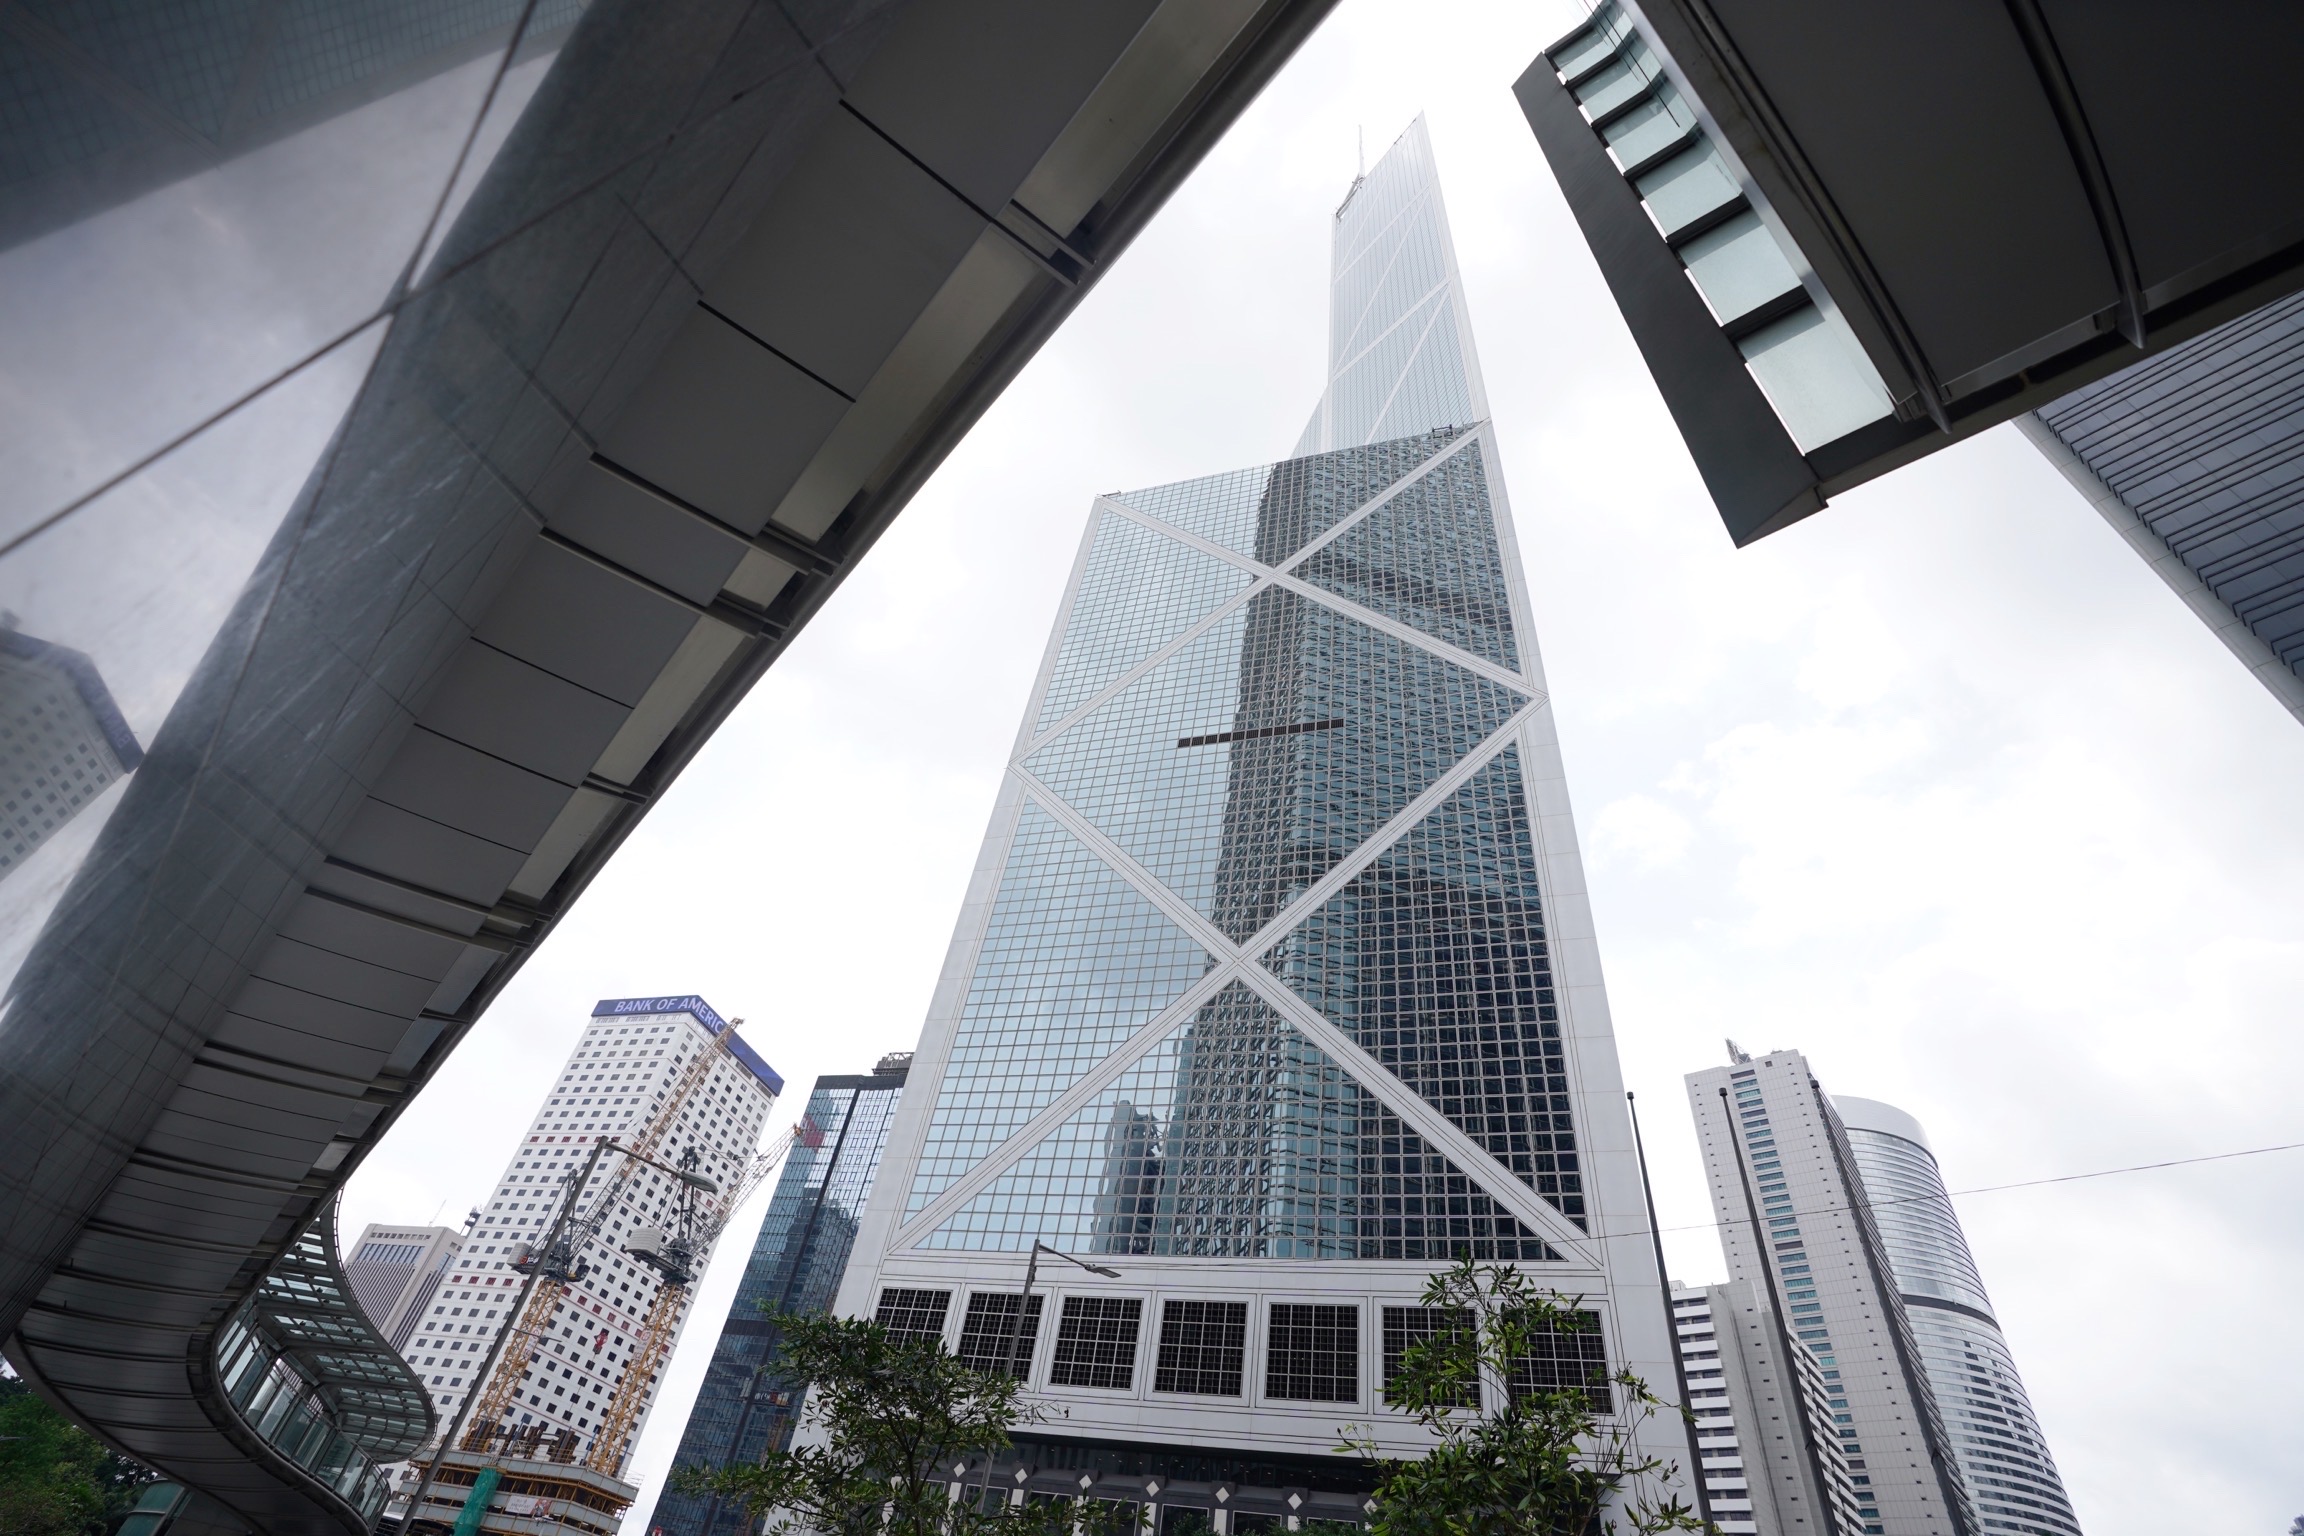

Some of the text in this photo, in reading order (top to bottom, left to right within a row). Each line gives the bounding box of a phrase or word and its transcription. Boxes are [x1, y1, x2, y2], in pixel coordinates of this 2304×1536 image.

[614, 997, 725, 1035] BANK OF AMERIC
